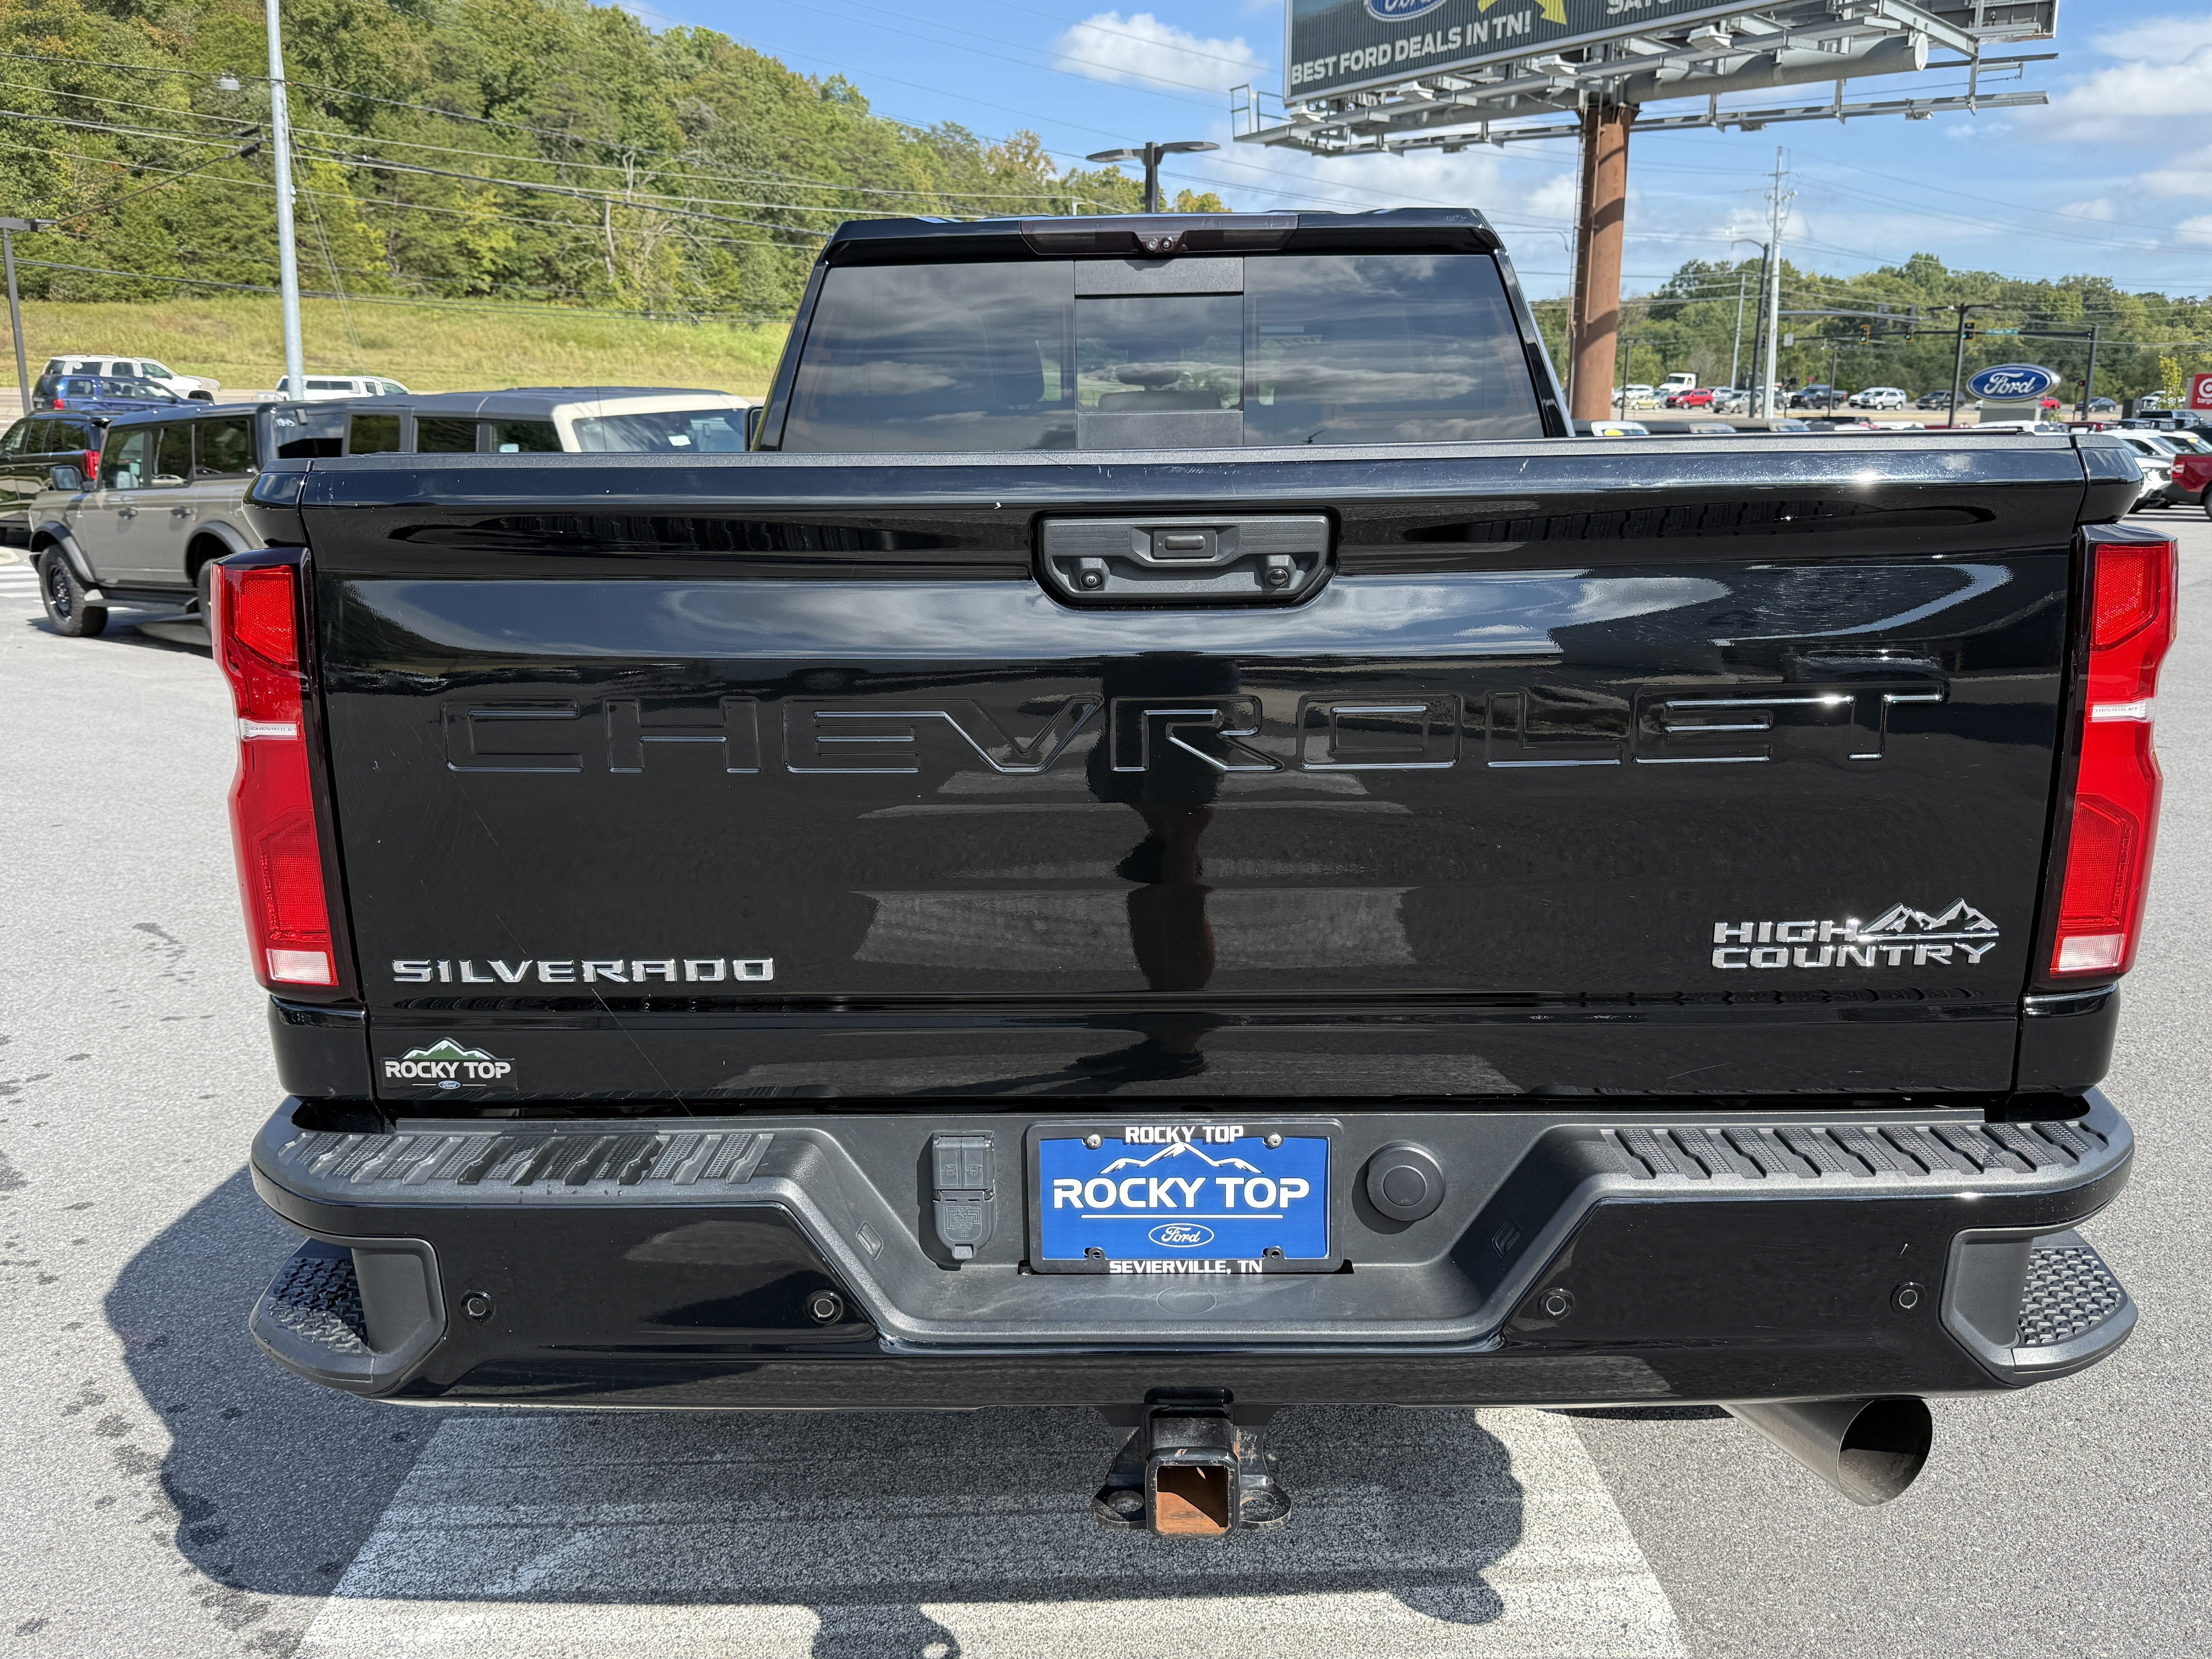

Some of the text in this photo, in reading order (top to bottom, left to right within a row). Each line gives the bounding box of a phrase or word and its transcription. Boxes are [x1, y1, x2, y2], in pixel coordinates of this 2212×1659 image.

[1291, 10, 1531, 85] BEST FORD DEALS IN TN!
[1983, 372, 2036, 394] Ford
[440, 680, 1949, 774] CHEVROLET
[1713, 919, 1859, 943] HIGH
[1712, 942, 1996, 968] COUNTRY
[392, 958, 774, 983] SILVERADO
[385, 1061, 511, 1079] ROCKY TOP
[1125, 1125, 1243, 1143] ROCKY TOP
[1053, 1177, 1310, 1209] ROCKY TOP
[1161, 1226, 1200, 1243] Ford
[1109, 1260, 1262, 1274] SEVIERVILLE, TN
